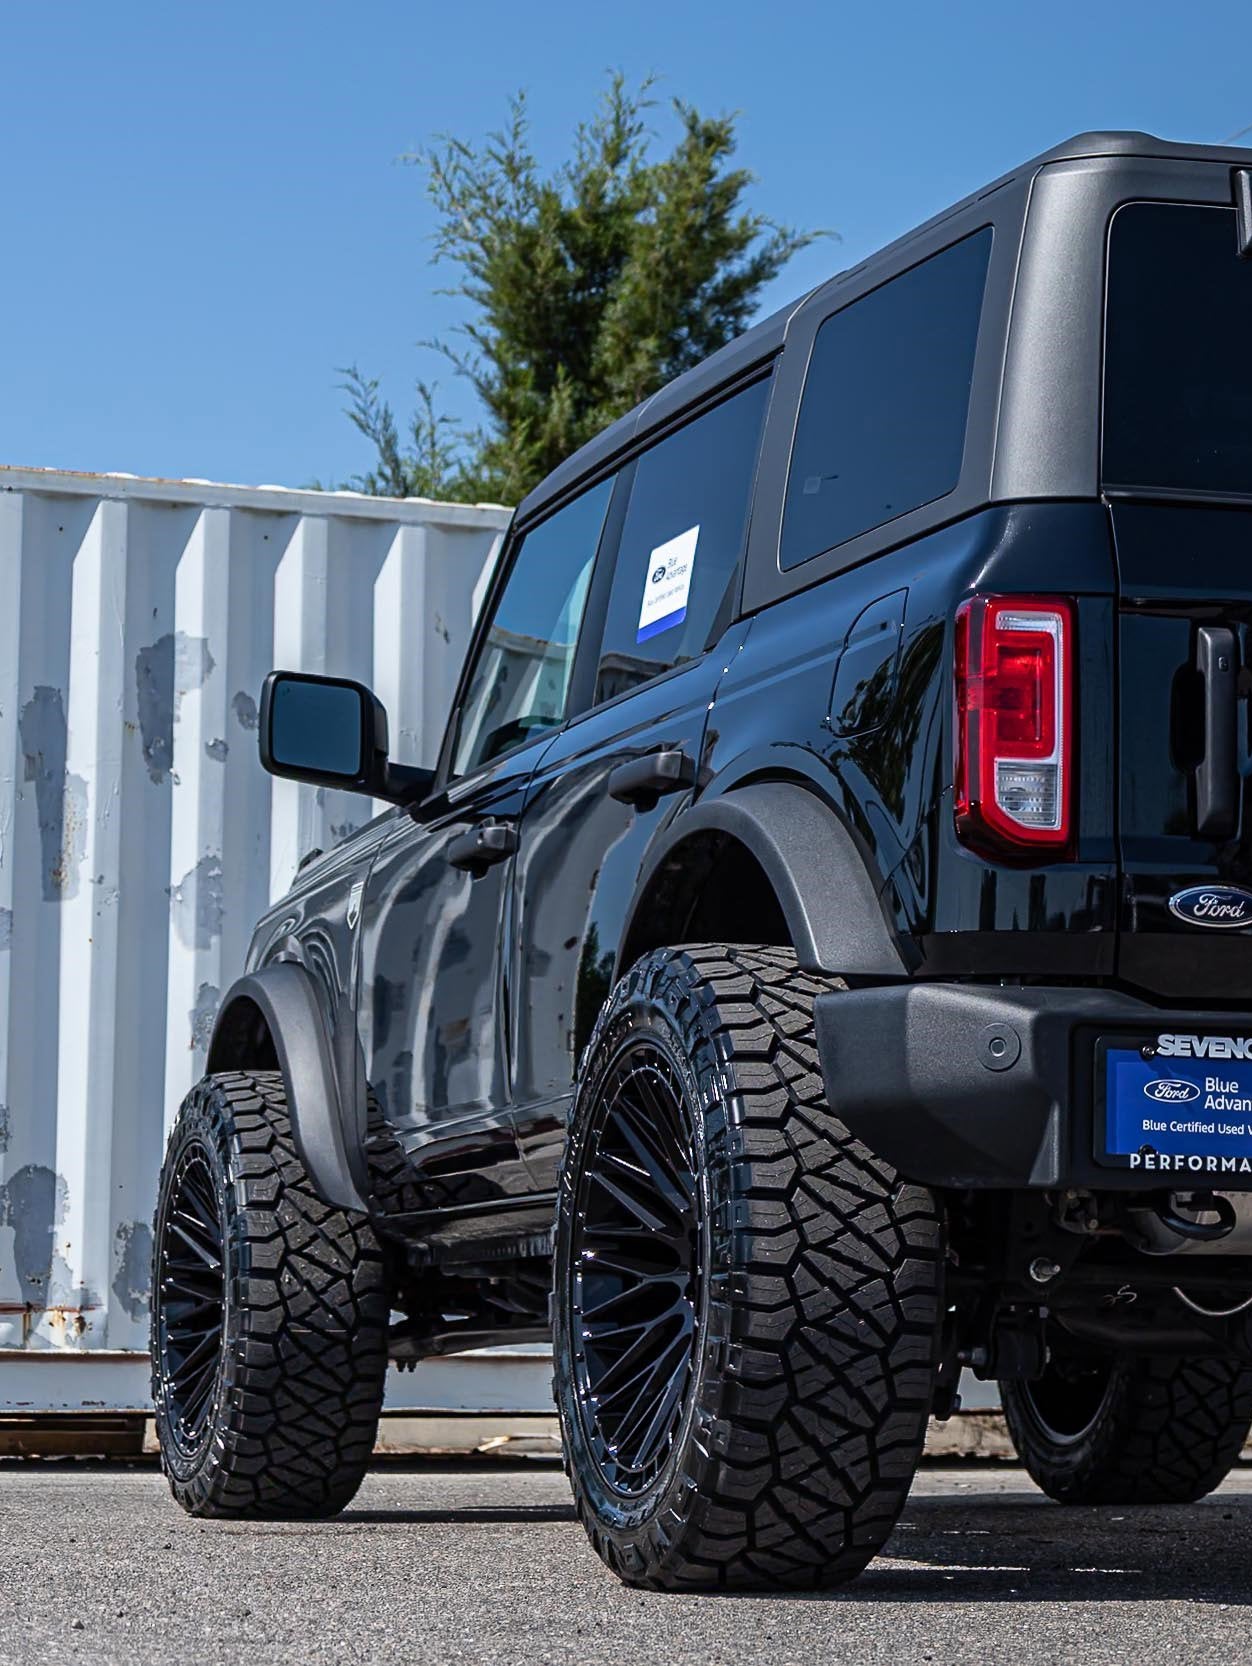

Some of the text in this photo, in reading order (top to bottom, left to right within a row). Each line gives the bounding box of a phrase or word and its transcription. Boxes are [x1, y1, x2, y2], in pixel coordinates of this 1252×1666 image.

[1193, 893, 1245, 917] Ford
[1205, 1077, 1239, 1094] Blue
[1142, 1119, 1167, 1132] Blue
[1170, 1120, 1215, 1134] Certified
[1217, 1123, 1245, 1135] Used
